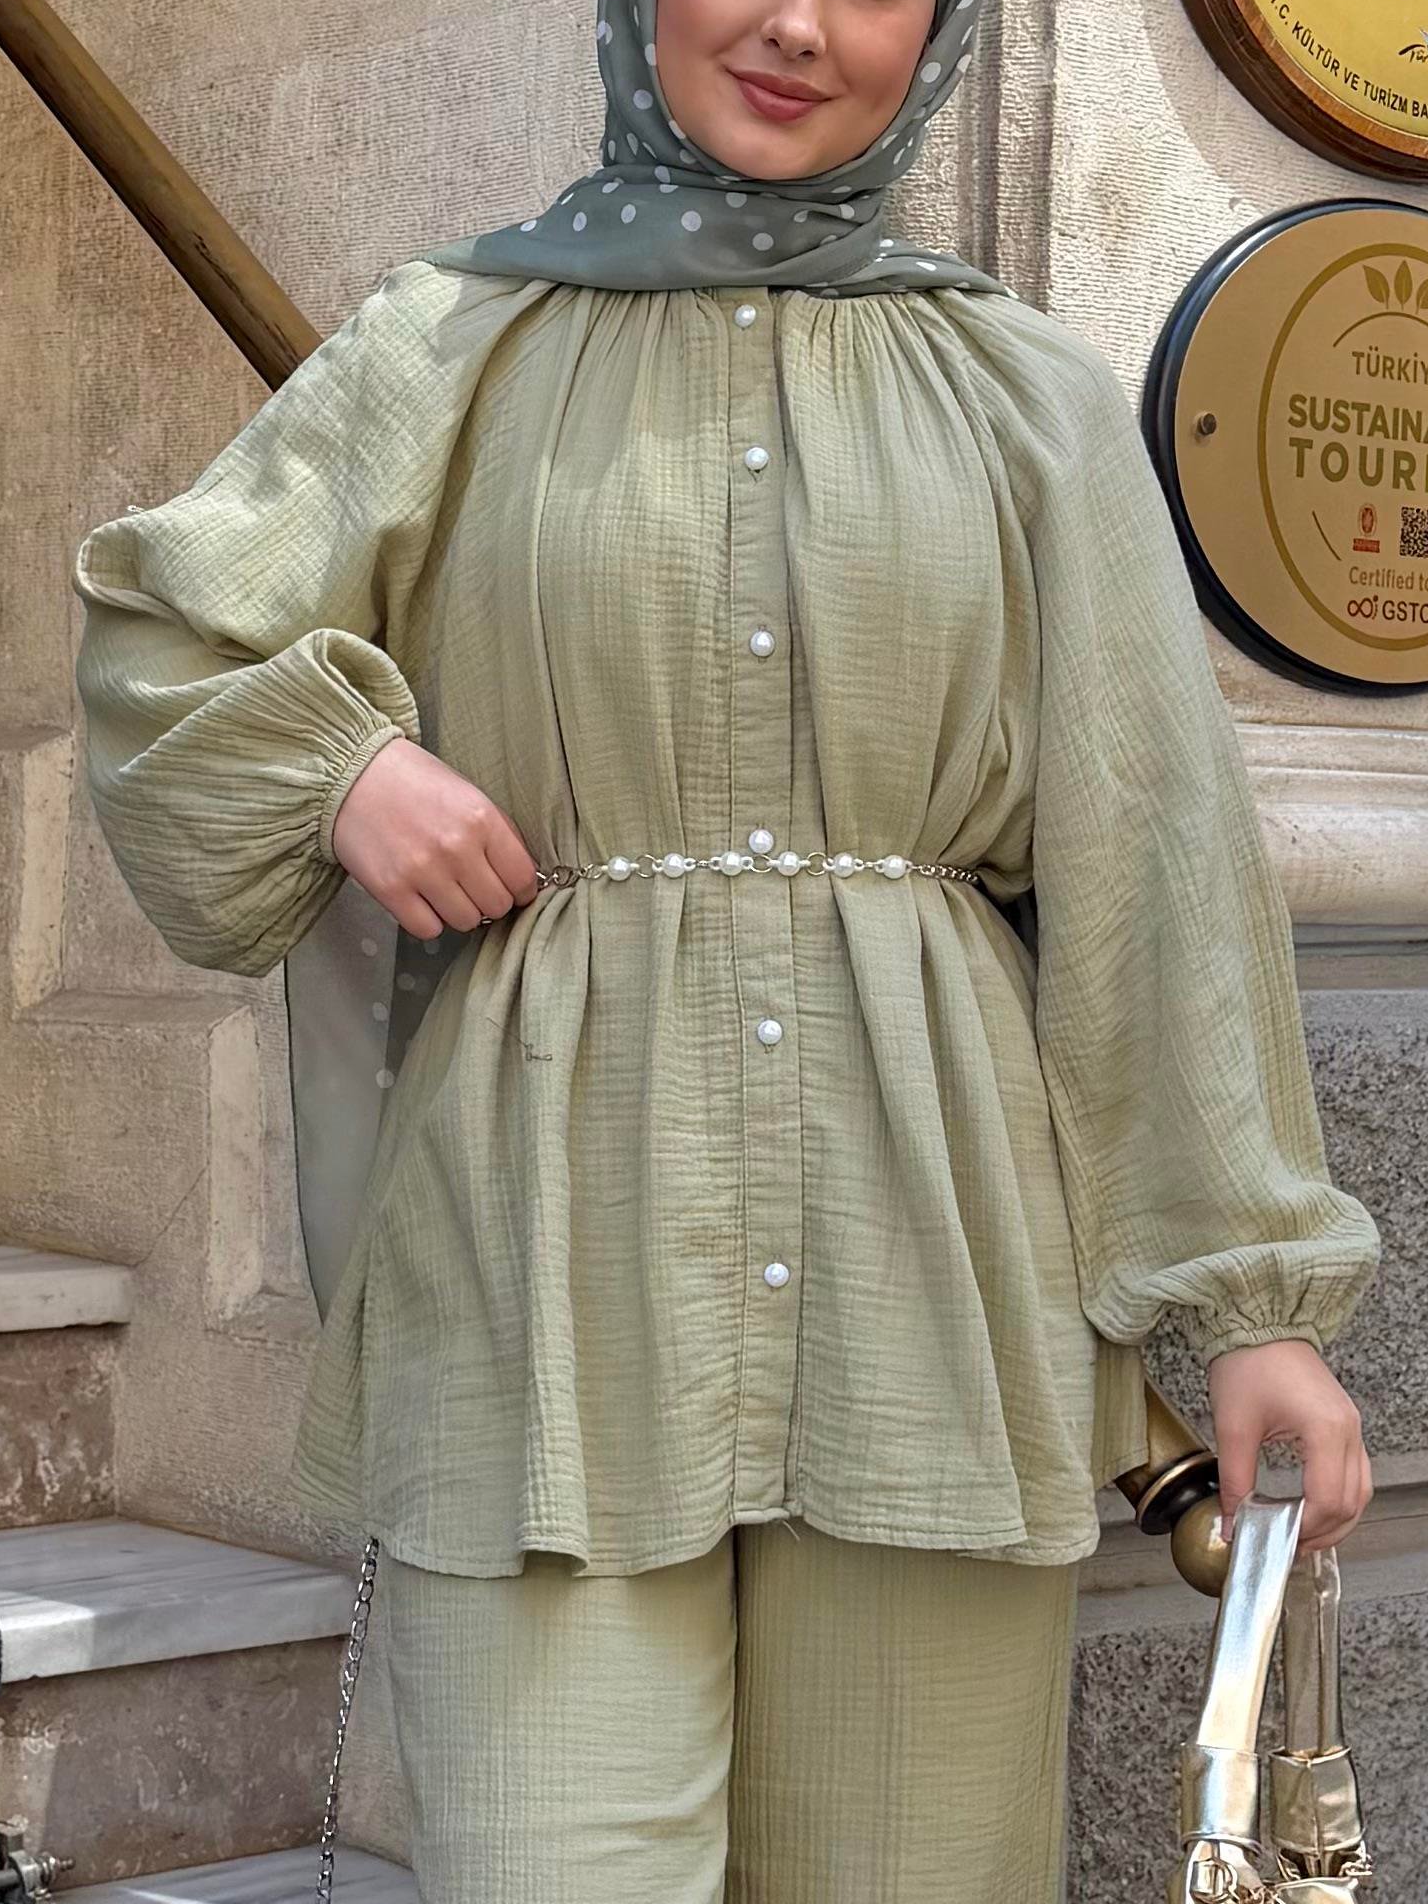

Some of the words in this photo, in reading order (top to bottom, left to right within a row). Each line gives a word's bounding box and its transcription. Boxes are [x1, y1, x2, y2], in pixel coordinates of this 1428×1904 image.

[1292, 21, 1341, 77] KÜLTÜR
[1343, 67, 1360, 91] VE
[1363, 80, 1408, 114] TURİZM
[1348, 566, 1415, 590] Certified
